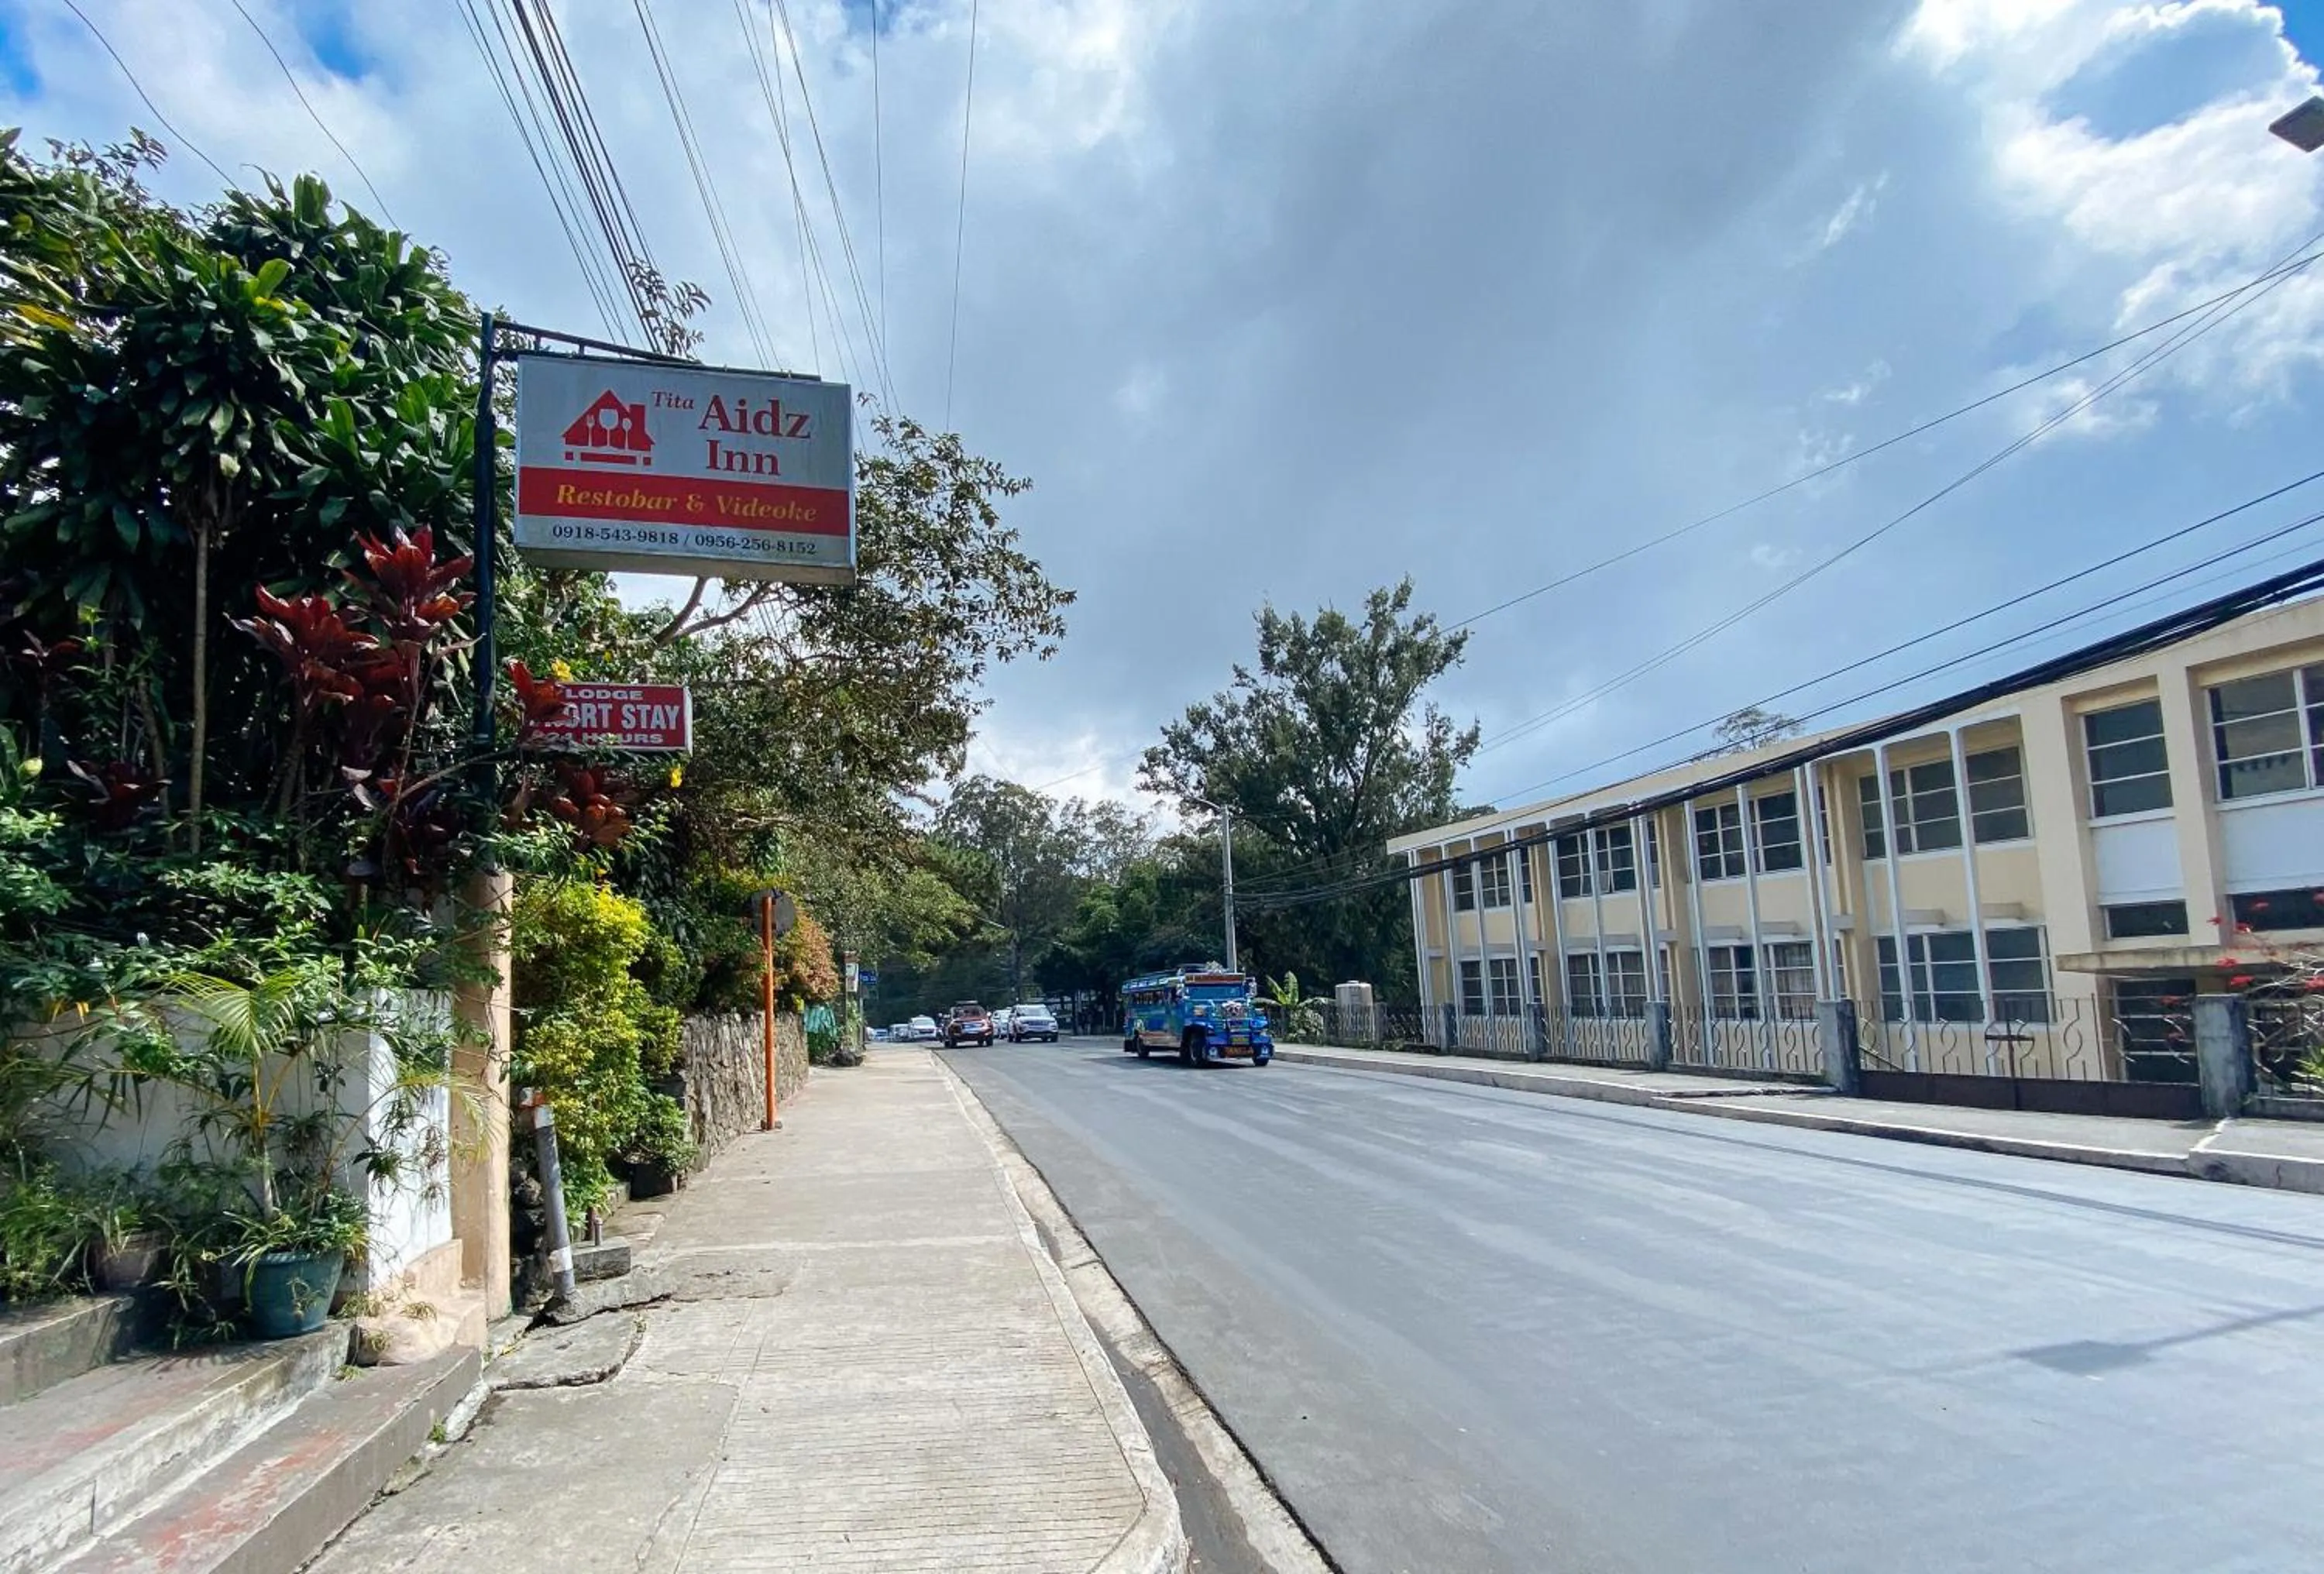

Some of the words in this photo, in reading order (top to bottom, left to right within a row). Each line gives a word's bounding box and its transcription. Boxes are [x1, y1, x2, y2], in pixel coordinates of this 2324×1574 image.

[651, 391, 694, 409] Tita
[699, 394, 811, 438] Aidz
[706, 439, 781, 476] Inn
[557, 484, 678, 510] Restobar
[686, 494, 704, 511] &
[717, 496, 817, 521] Videoke
[552, 524, 678, 544] 0918-543-9818
[684, 532, 690, 545] /
[695, 534, 816, 555] 0956-256-8152
[565, 689, 643, 700] LODGE
[533, 703, 612, 727] ORT
[621, 704, 680, 729] STAY
